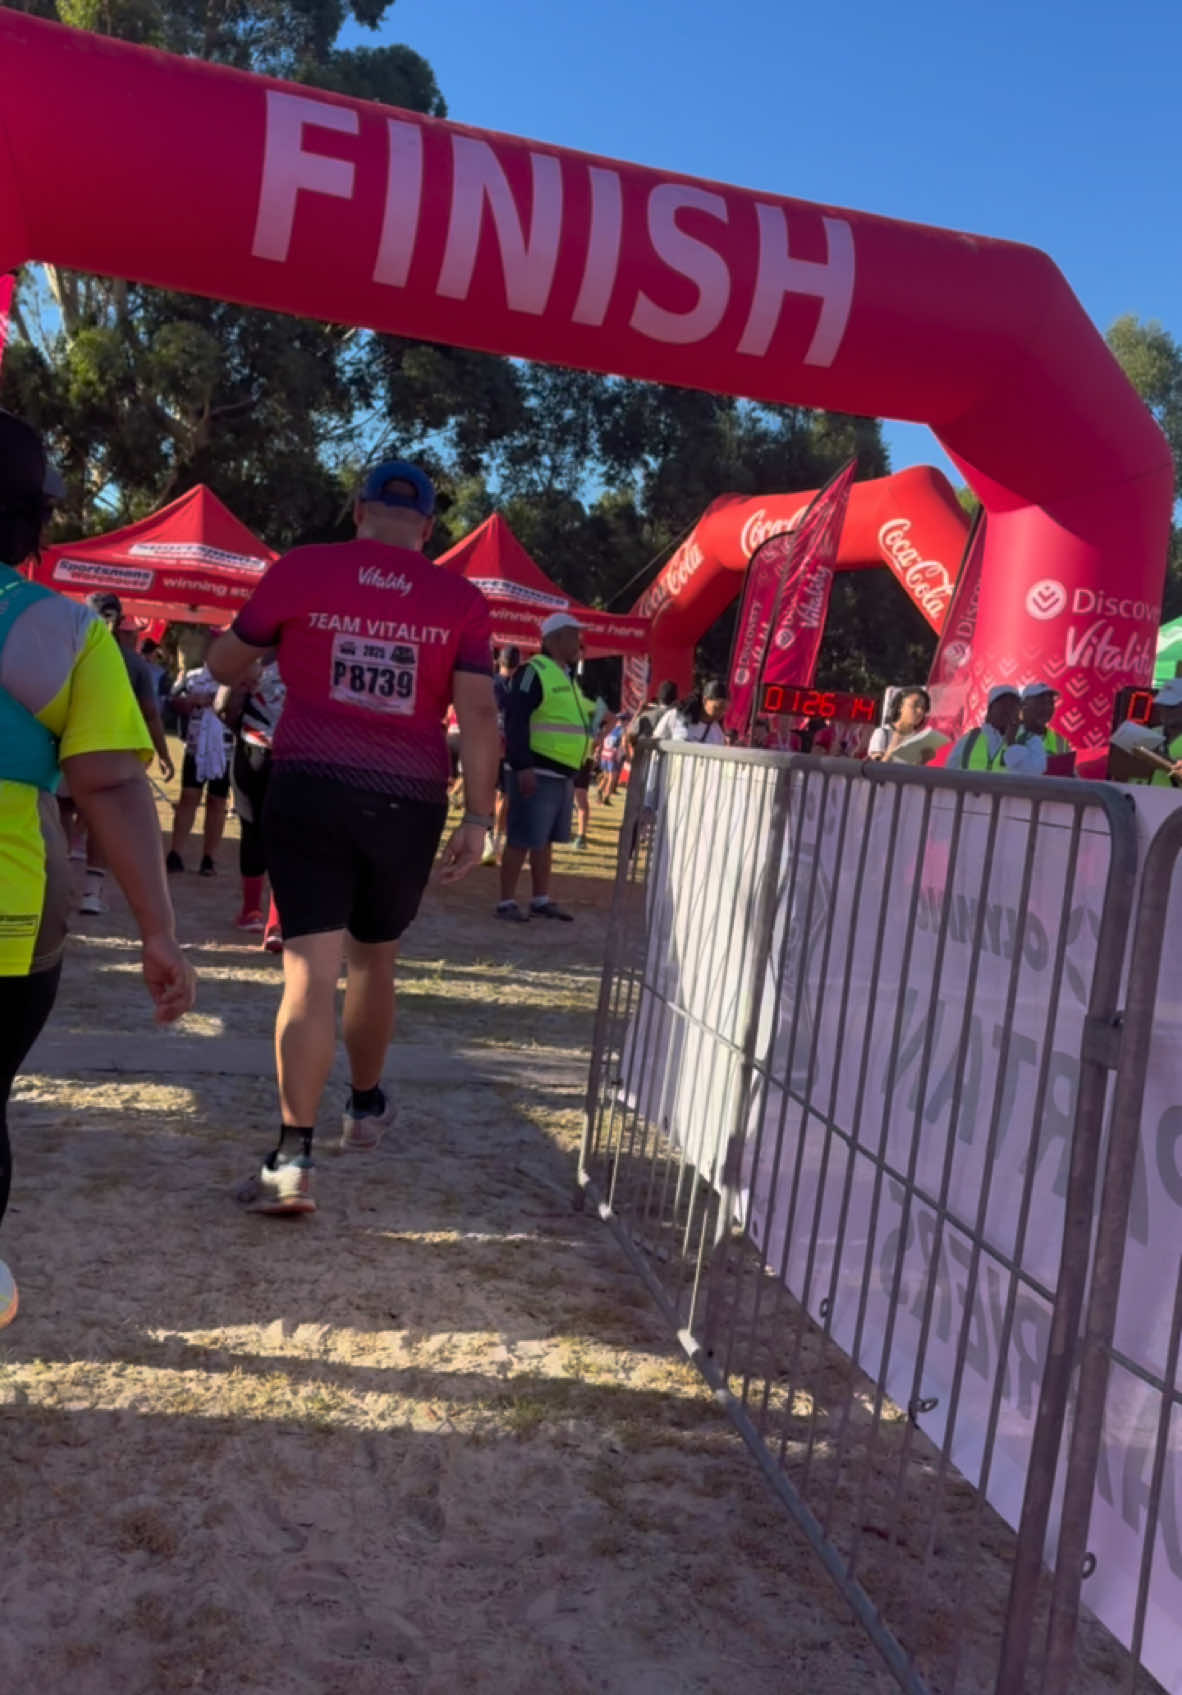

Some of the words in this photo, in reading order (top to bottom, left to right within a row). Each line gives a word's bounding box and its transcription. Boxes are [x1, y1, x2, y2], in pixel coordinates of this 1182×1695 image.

[251, 89, 856, 368] FINISH
[162, 576, 227, 597] winning
[358, 566, 413, 598] Vitality
[308, 613, 362, 633] TEAM
[366, 618, 451, 645] VITALITY
